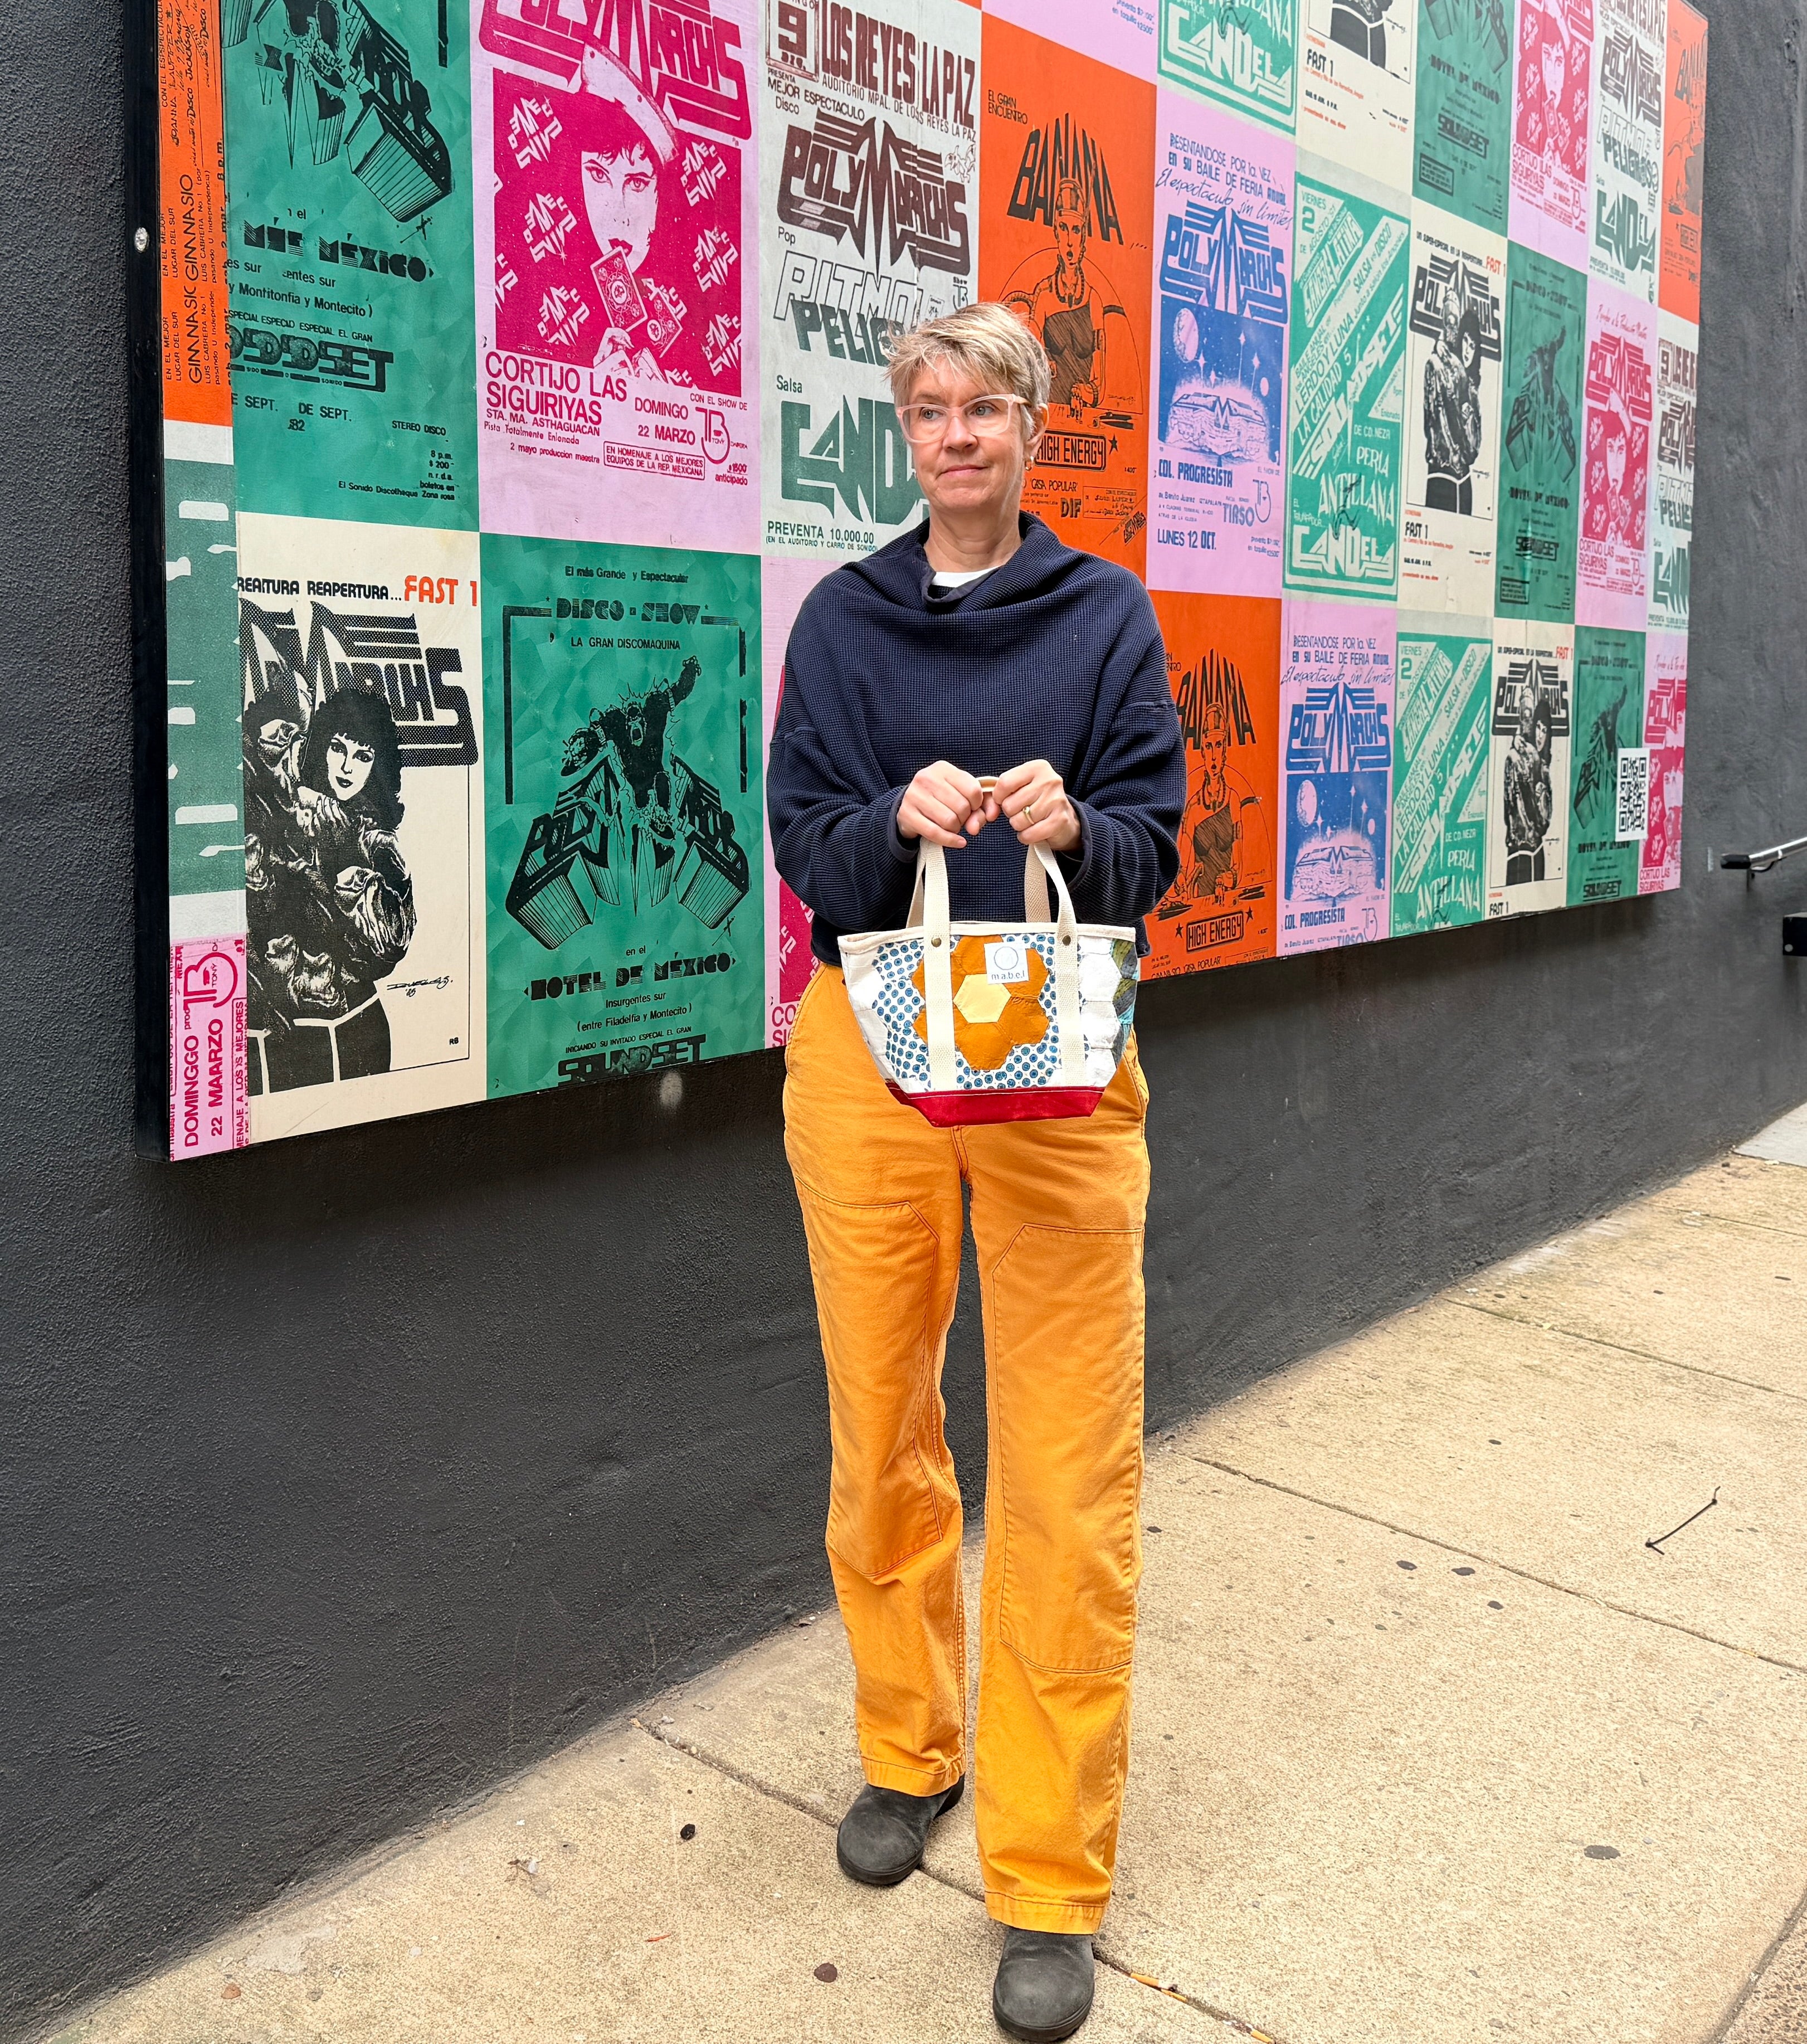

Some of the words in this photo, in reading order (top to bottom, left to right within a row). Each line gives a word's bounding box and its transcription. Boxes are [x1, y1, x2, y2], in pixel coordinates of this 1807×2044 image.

[855, 12, 916, 105] REYES
[922, 41, 941, 119] LA
[942, 49, 976, 129] PAZ
[1306, 48, 1327, 74] FAST
[767, 76, 800, 100] MEJOR
[804, 90, 865, 121] ESPECTACULO
[775, 96, 800, 115] Disco
[822, 74, 864, 101] AUDITORIO
[868, 90, 891, 110] MPAL.
[893, 99, 904, 116] DE
[927, 113, 949, 134] REYES
[962, 128, 977, 143] PAZ
[997, 93, 1017, 110] GRAN
[988, 102, 1027, 124] ENCUENTRO
[1230, 155, 1246, 173] POR
[1196, 159, 1220, 183] BAILE
[1225, 171, 1237, 189] DE
[1239, 175, 1264, 199] FERIA
[179, 174, 199, 282] GIMNASIO
[1302, 206, 1316, 233] 2
[198, 218, 206, 259] CABRERA
[778, 226, 796, 245] Pop
[169, 249, 178, 278] LUGAR
[199, 263, 208, 282] LUIS
[319, 276, 336, 288] sur
[201, 320, 210, 362] CABRERA
[299, 322, 335, 336] ESPECIAL
[352, 331, 373, 343] GRAN
[173, 352, 182, 381] LUGAR
[201, 363, 211, 384] LUIS
[485, 351, 581, 395] CORTIJO
[589, 371, 627, 402] LAS
[776, 375, 803, 394] Salsa
[244, 395, 278, 412] SEPT.
[298, 402, 314, 416] DE
[319, 405, 352, 422] SEPT.
[486, 381, 602, 425] SIGUIRIYAS
[635, 397, 689, 421] DOMINGO
[690, 392, 705, 403] CON
[707, 396, 715, 405] EL
[718, 397, 737, 408] SHOW
[738, 401, 748, 411] DE
[392, 421, 421, 433] STEREO
[424, 424, 446, 436] DISCO
[483, 421, 501, 433] Pista
[504, 423, 544, 440] Totalmente
[548, 432, 580, 446] Enlonada
[486, 408, 508, 422] STA.
[509, 411, 528, 426] MA.
[532, 416, 601, 437] ASTHAGUACAN
[637, 425, 650, 437] 22
[654, 425, 696, 446] MARZO
[518, 444, 537, 455] mayo
[539, 446, 573, 461] produccion
[606, 445, 615, 454] EN
[617, 446, 652, 461] HOMENAJE
[661, 453, 674, 463] LOS
[676, 454, 704, 468] MEJORES
[1063, 436, 1104, 466] ENERGY
[1356, 446, 1390, 478] PERLA
[606, 454, 634, 466] EQUIPOS
[672, 464, 703, 477] MEXICANA
[1177, 461, 1233, 488] PROGRESISTA
[715, 473, 748, 486] anticipado
[1060, 497, 1082, 519] DIF
[1222, 502, 1255, 527] TIRSO
[767, 520, 824, 539] PREVENTA
[830, 528, 874, 544] 10.000.00
[1157, 528, 1185, 547] LUNES
[1187, 530, 1198, 549] 12
[1200, 530, 1217, 551] OCT.
[1405, 521, 1423, 539] FAST
[787, 538, 819, 548] AUDITORIO
[596, 567, 626, 580] Grande
[404, 575, 459, 605] FAST
[556, 597, 625, 621] DISCO
[571, 636, 583, 647] LA
[589, 637, 613, 648] GRAN
[617, 638, 680, 650] DISCOMAQUINA
[1342, 637, 1356, 649] POR
[1314, 651, 1336, 664] BAILE
[1338, 653, 1347, 664] DE
[1351, 652, 1370, 665] FERIA
[1401, 658, 1412, 679] 2
[1299, 908, 1345, 928] PROGRESISTA
[1188, 923, 1206, 948] HIGH
[1209, 914, 1242, 943] ENERGY
[626, 947, 636, 956] en
[639, 945, 646, 954] el
[606, 994, 651, 1010] Insurgentes
[654, 992, 666, 1001] sur
[235, 1001, 244, 1052] MEJORES
[577, 1019, 603, 1033] (entre
[605, 1013, 641, 1028] Filadelfia
[565, 1041, 597, 1054] INICIANDO
[610, 1034, 636, 1045] INVITADO
[639, 1030, 664, 1041] ESPECIAL
[676, 1025, 693, 1034] GRAN
[208, 1018, 223, 1108] MAARZO
[183, 1035, 199, 1147] DOMINGGO
[211, 1115, 223, 1137] 22
